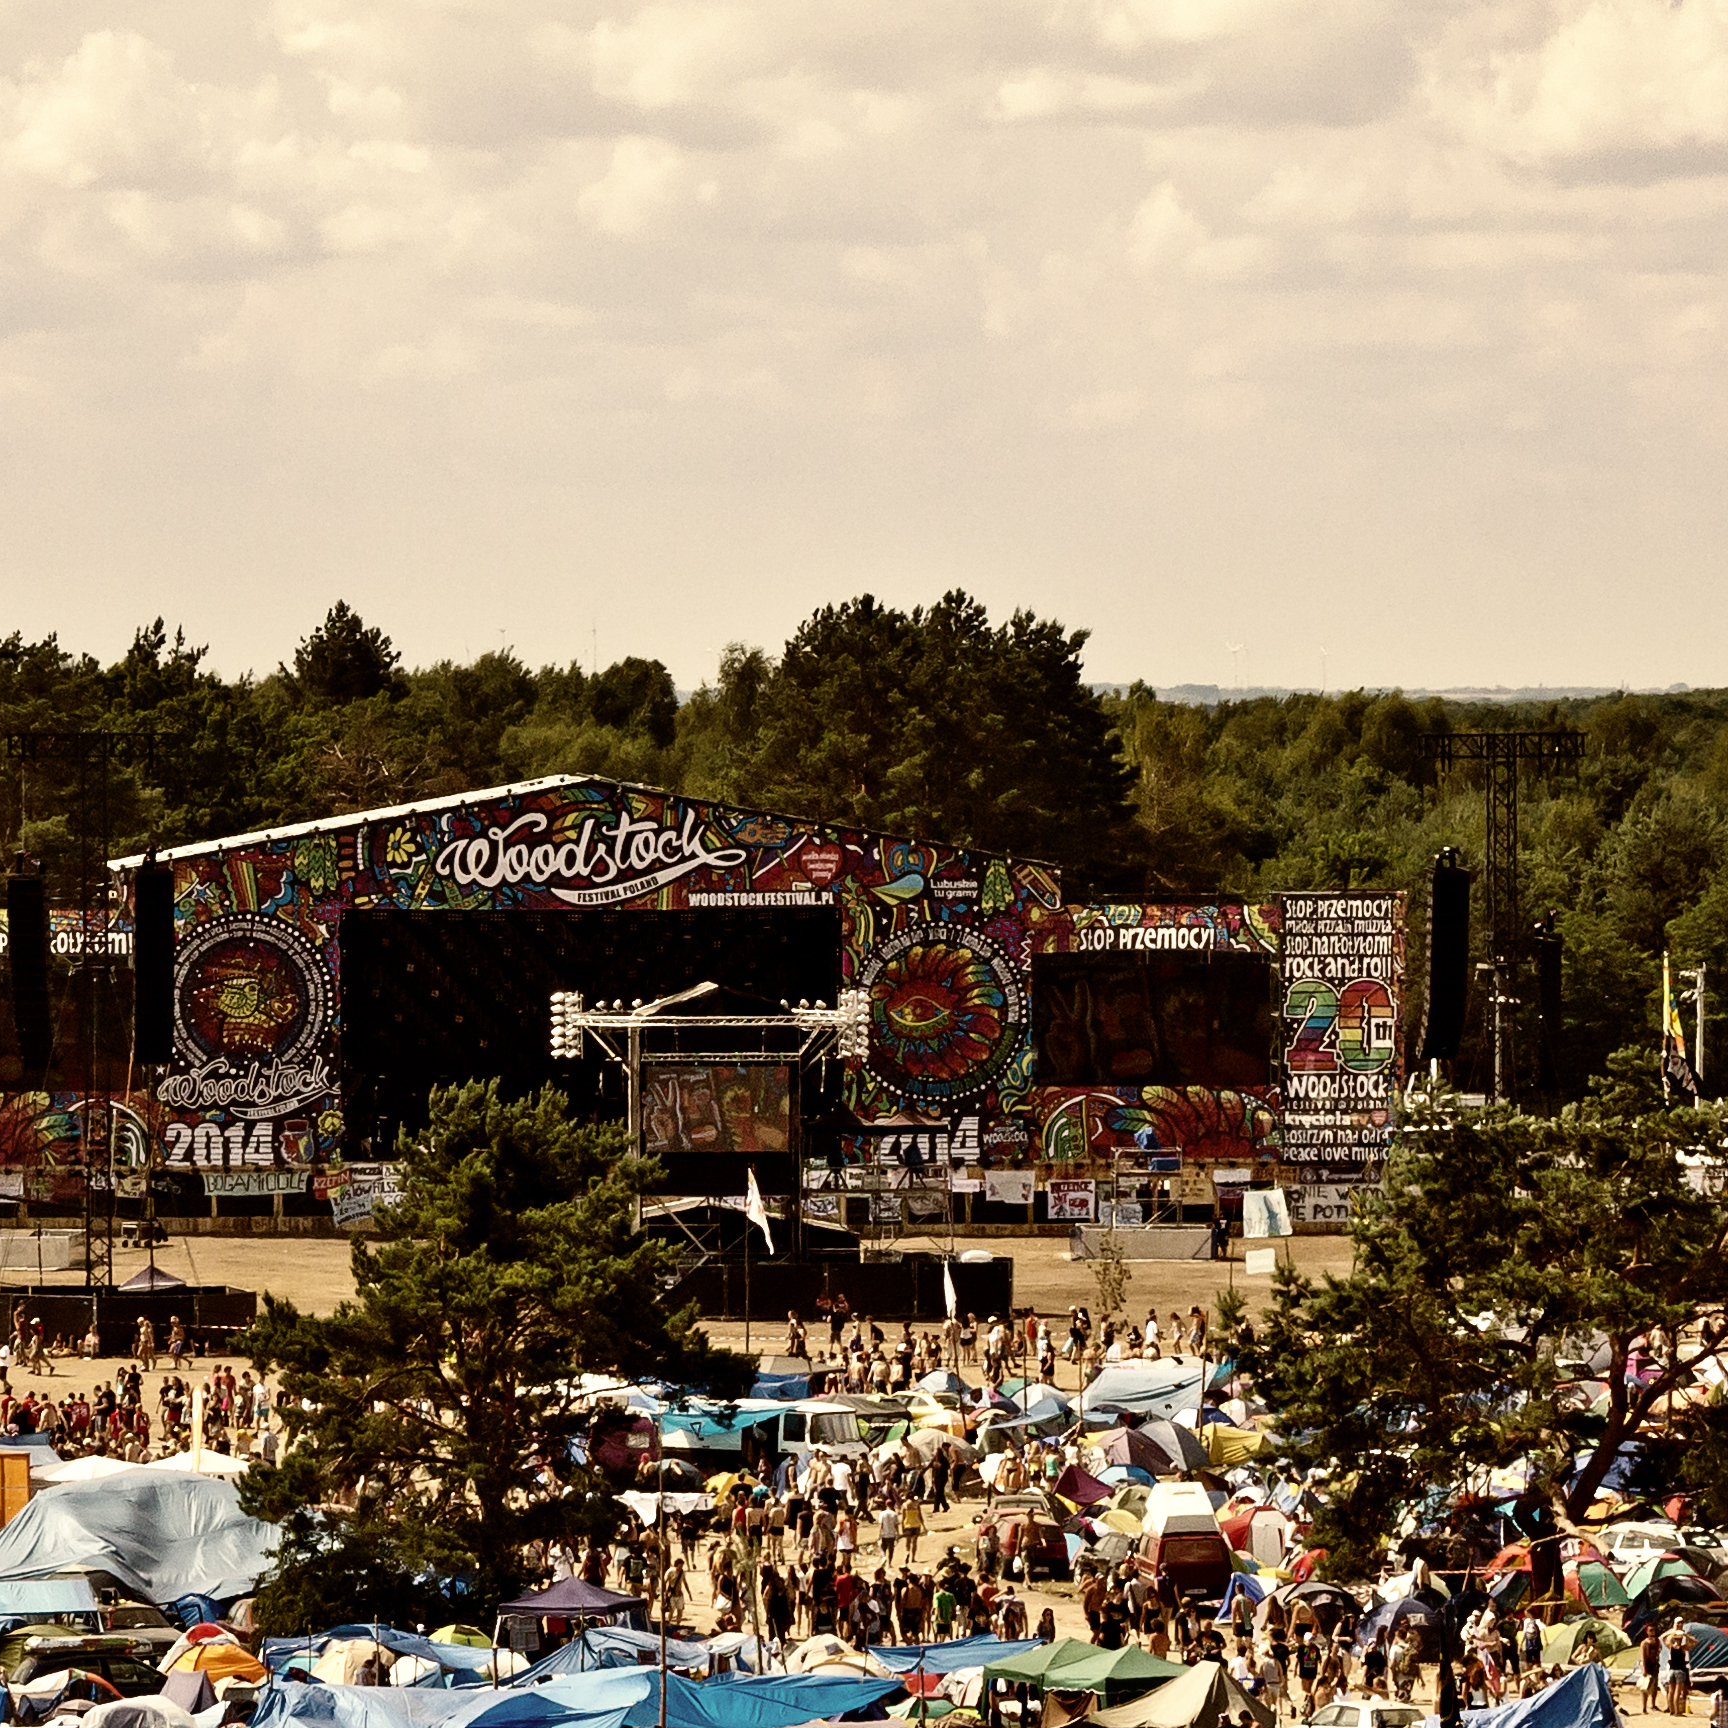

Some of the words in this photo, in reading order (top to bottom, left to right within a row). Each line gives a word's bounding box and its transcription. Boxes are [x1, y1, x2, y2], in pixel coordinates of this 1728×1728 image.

[435, 807, 747, 887] Woodstock
[577, 887, 621, 903] FESTIVAL
[623, 876, 659, 895] POLAND
[688, 891, 834, 906] WOODSTOCKFESTIVAL.PL
[930, 878, 978, 889] Lubuskie
[157, 1055, 341, 1109] Woodstock
[165, 1122, 273, 1166] 2014
